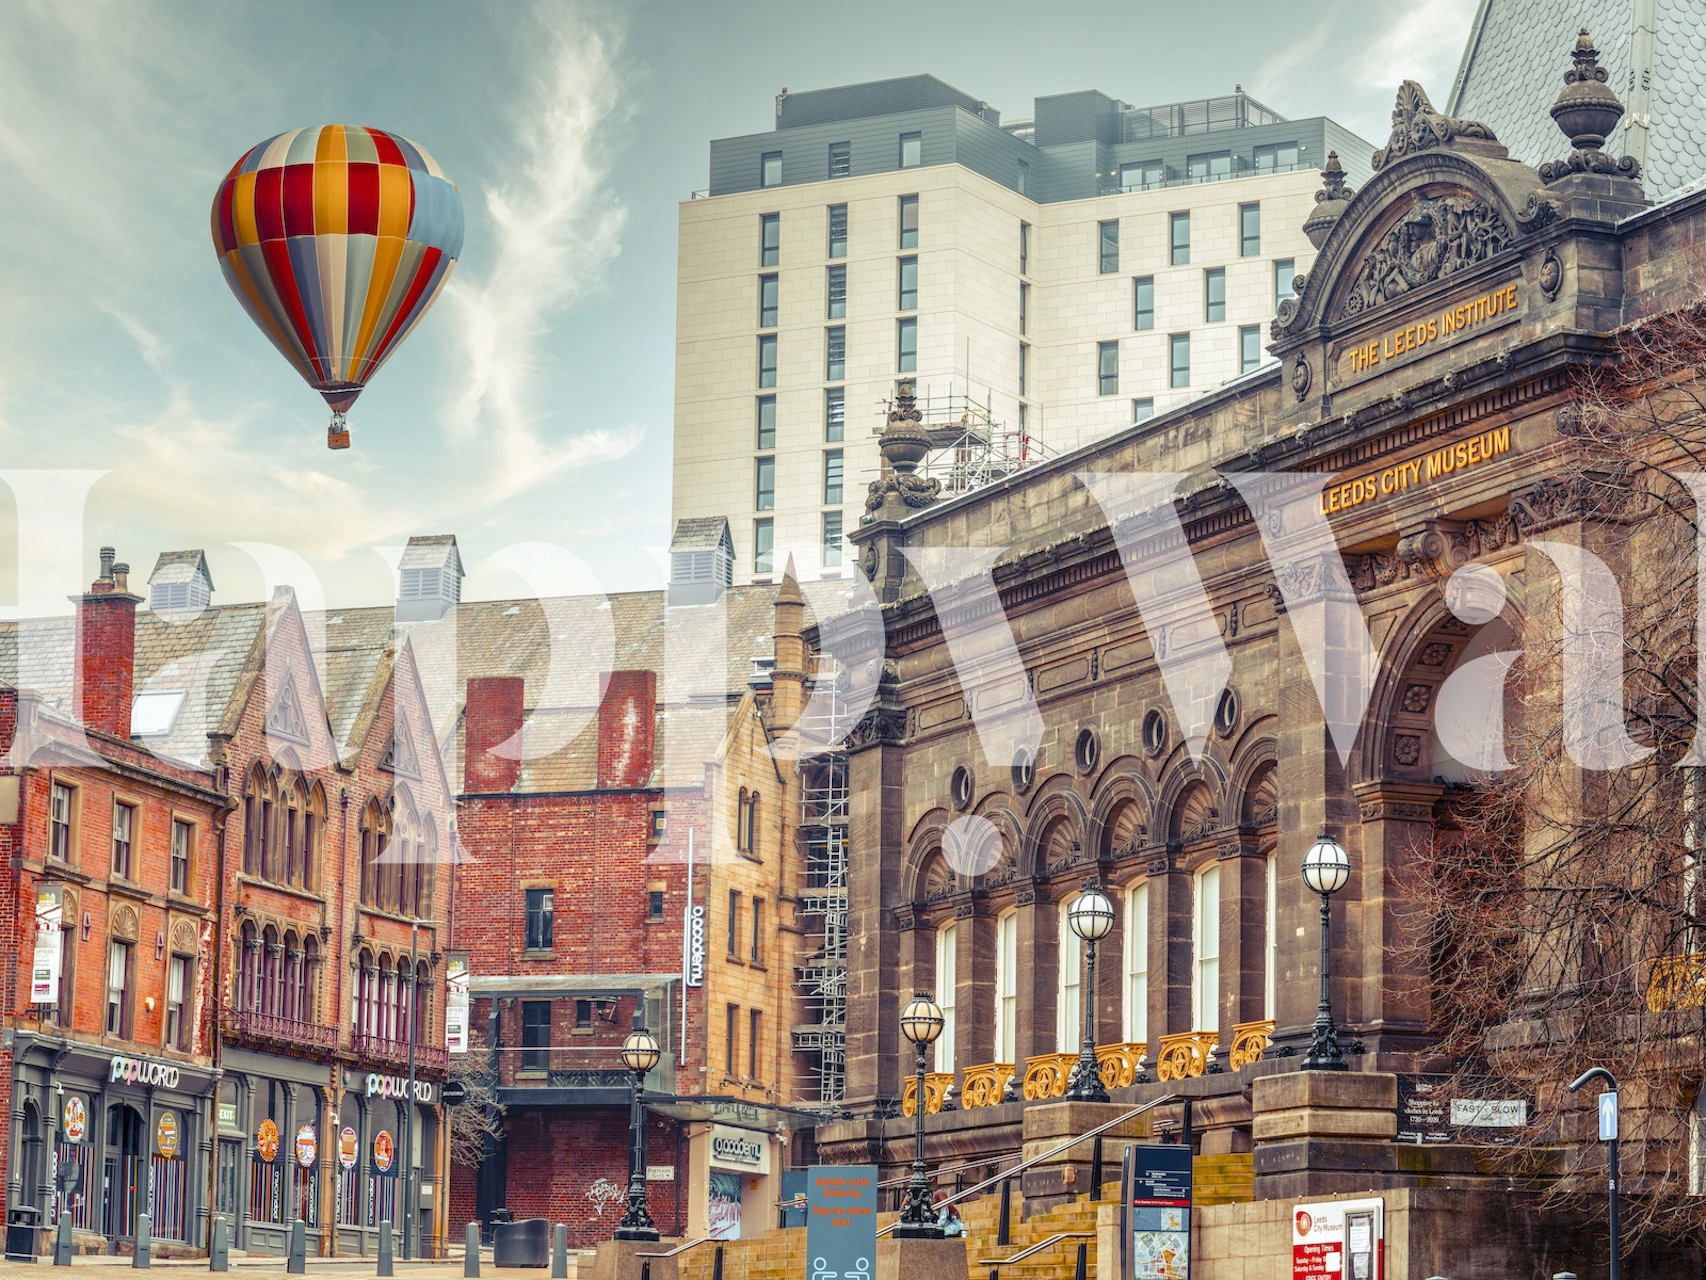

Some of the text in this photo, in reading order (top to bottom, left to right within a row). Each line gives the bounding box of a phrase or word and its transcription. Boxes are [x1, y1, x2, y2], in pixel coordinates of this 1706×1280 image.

[1349, 284, 1518, 372] THE LEEDS INSTITUTE
[1319, 427, 1512, 516] LEEDS CITY MUSEUM
[220, 1109, 233, 1120] EXIT
[1456, 1104, 1481, 1113] FAST
[1491, 1105, 1519, 1114] SLOW
[815, 1177, 871, 1186] Maintain social
[813, 1205, 830, 1216] Keep
[1313, 1215, 1328, 1224] Leeds
[1313, 1224, 1343, 1233] City Museum
[1304, 1244, 1335, 1255] Opening Times
